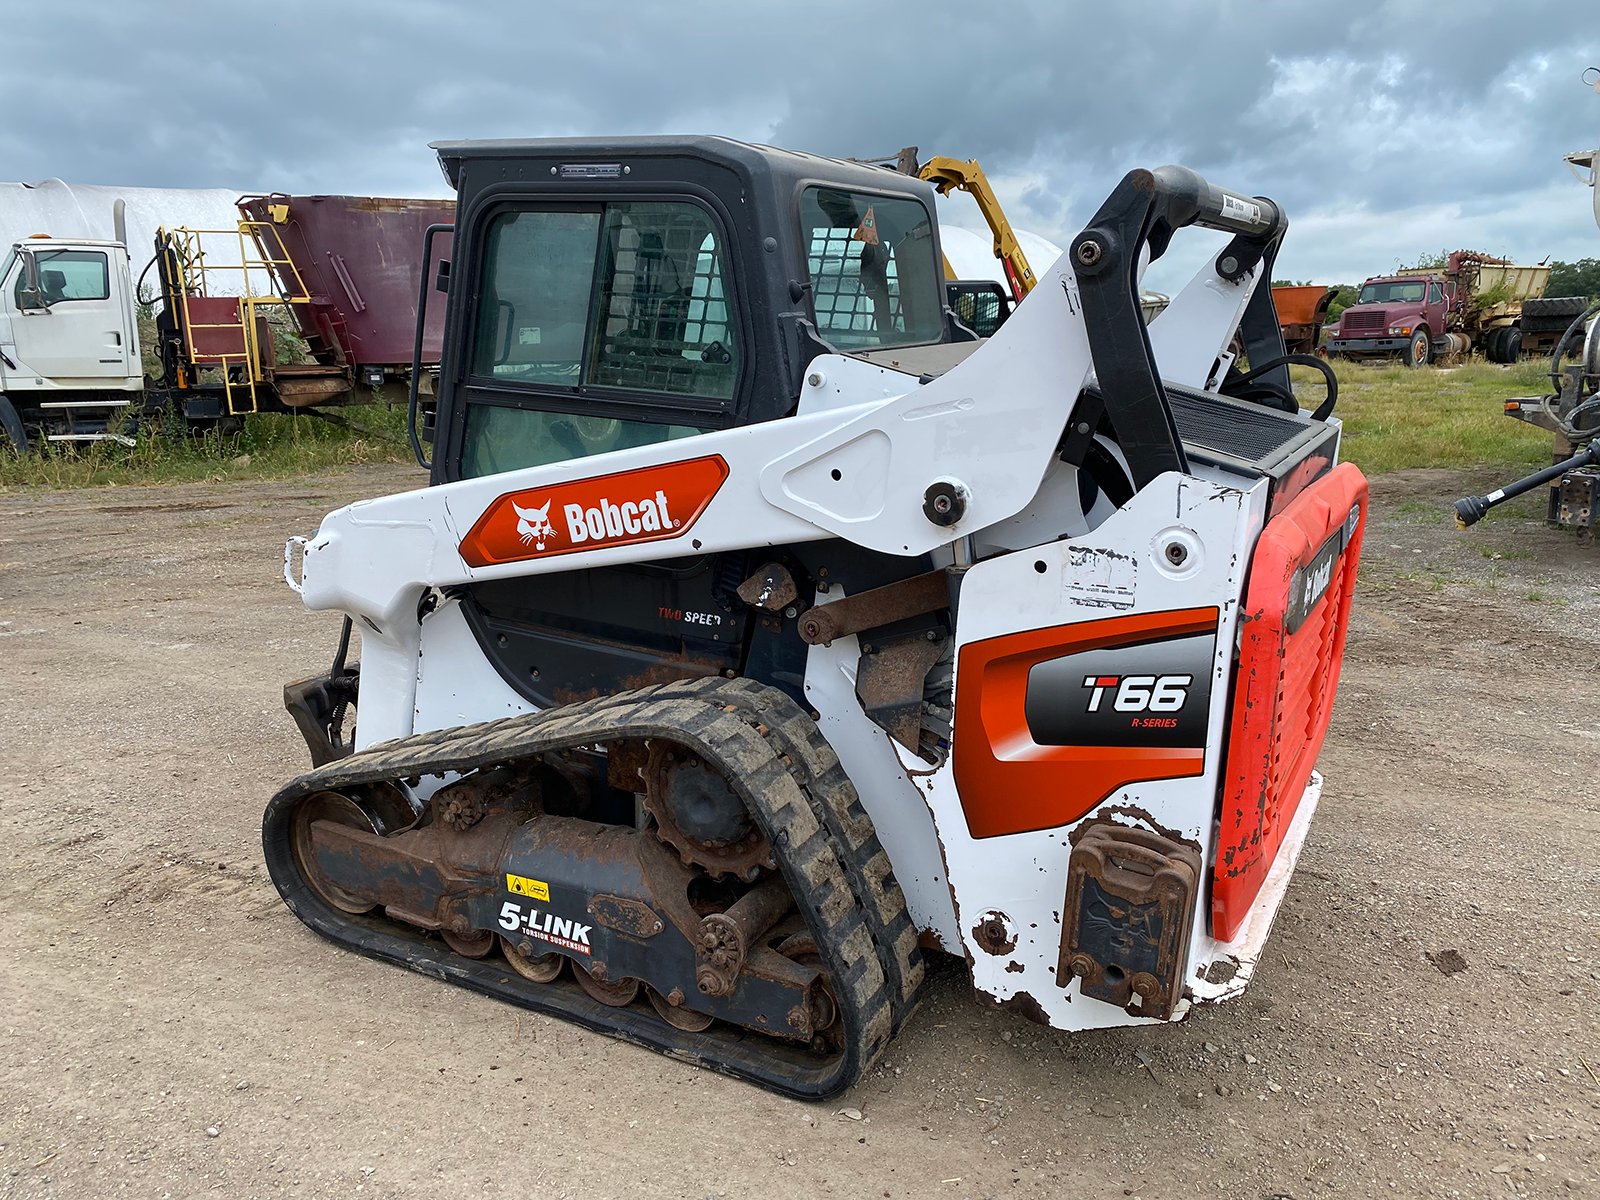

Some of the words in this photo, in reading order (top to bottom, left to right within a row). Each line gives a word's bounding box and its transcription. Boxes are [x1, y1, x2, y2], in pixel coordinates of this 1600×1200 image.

[563, 490, 673, 543] Bobcat
[658, 607, 682, 620] TWO
[1083, 675, 1193, 712] T66
[1131, 718, 1178, 728] R-SERIES
[498, 901, 592, 945] 5-LINK
[522, 926, 549, 942] TORSION
[549, 935, 589, 954] SUSPENSION
